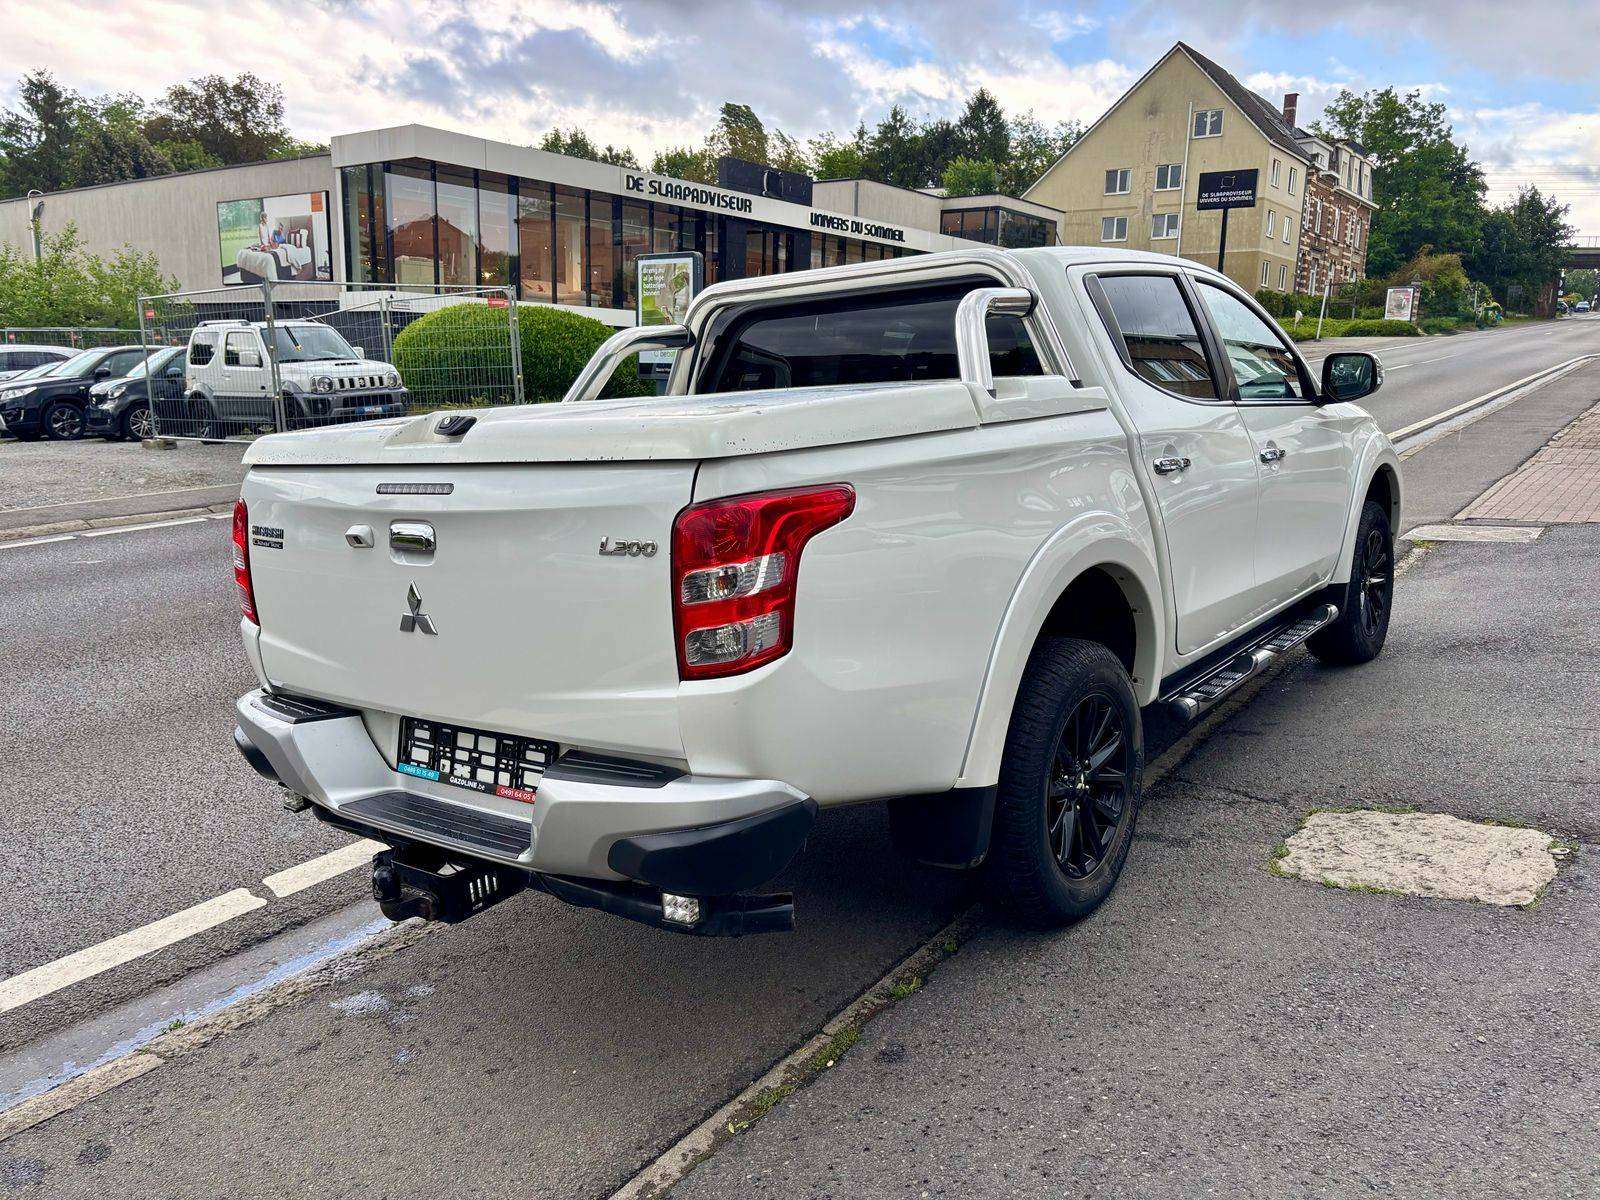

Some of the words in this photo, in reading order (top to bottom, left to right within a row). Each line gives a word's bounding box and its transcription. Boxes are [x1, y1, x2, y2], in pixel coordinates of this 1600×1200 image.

[626, 174, 644, 192] DE
[649, 180, 752, 213] SLAAPADVISEUR
[810, 212, 849, 231] UNIVERS
[851, 220, 863, 234] DU
[864, 223, 905, 242] SOMMEIL
[599, 536, 658, 557] L200
